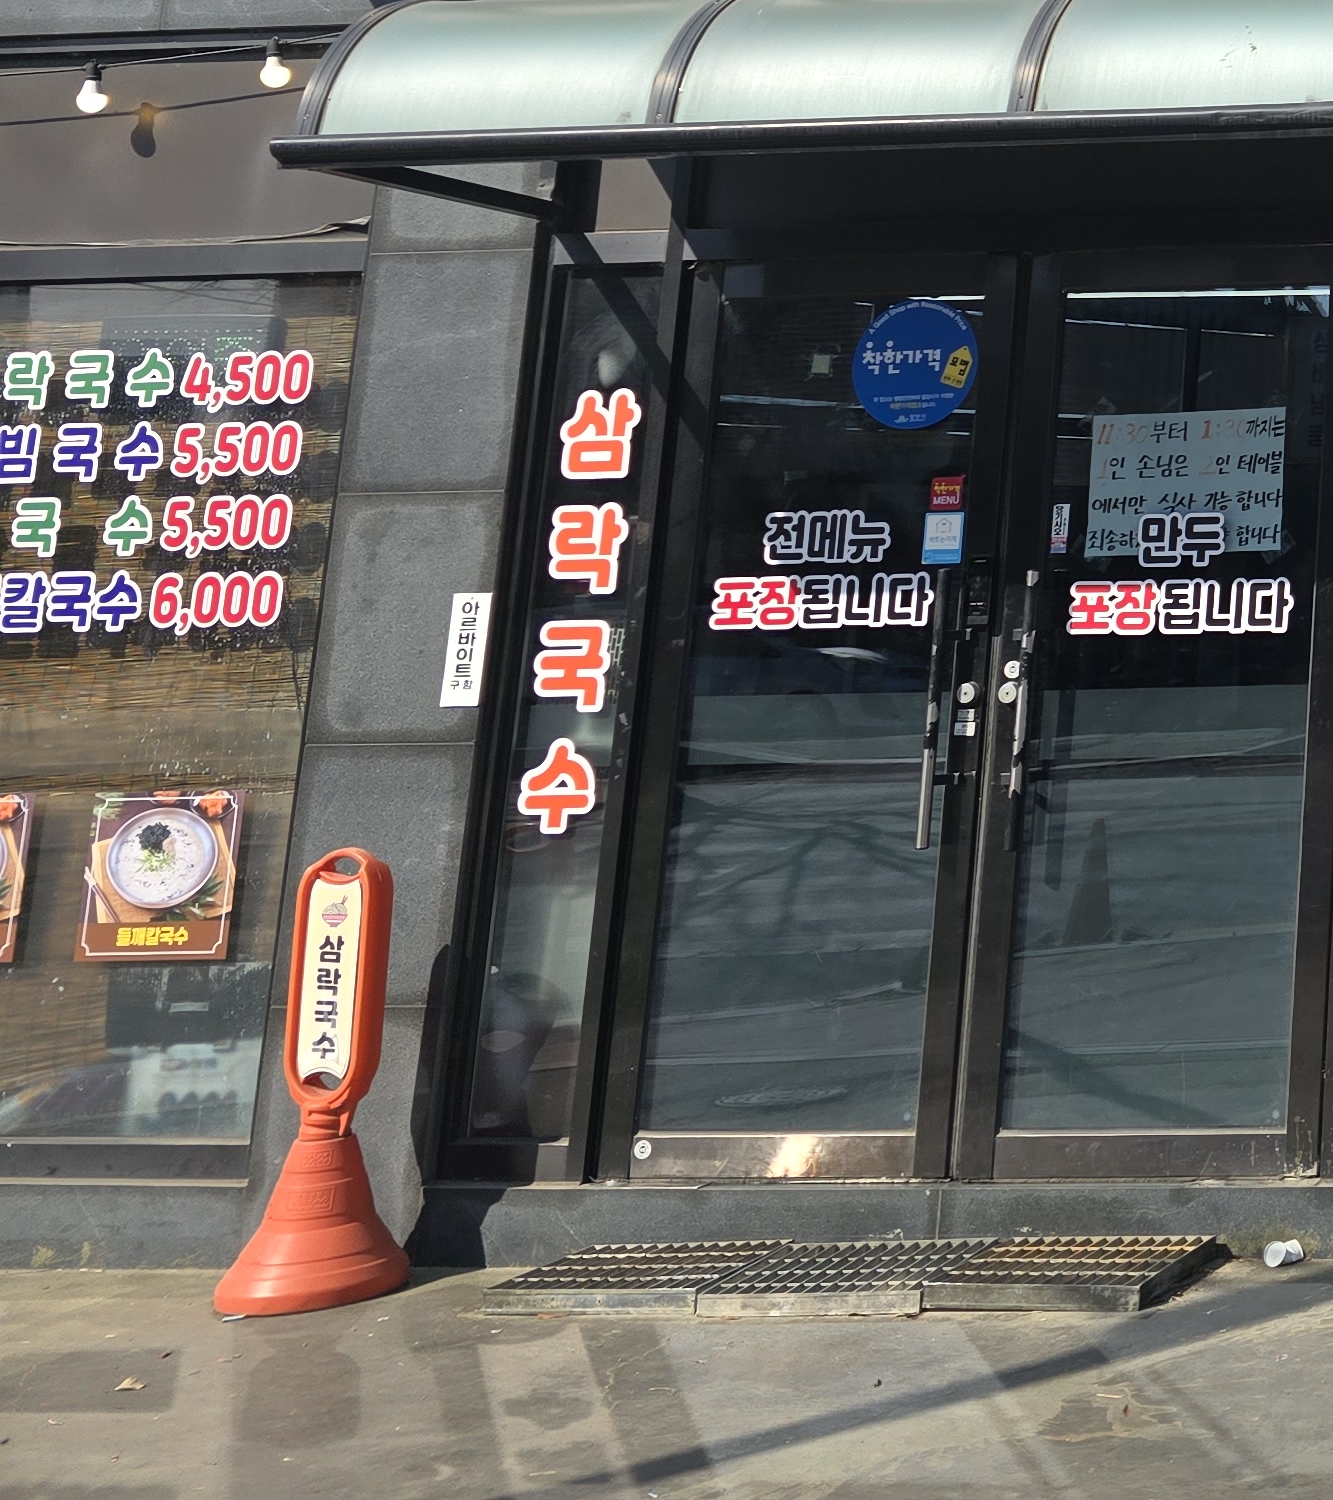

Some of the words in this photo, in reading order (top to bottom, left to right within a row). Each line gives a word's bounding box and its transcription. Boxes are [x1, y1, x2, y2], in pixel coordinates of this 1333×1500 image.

[180, 349, 314, 412] 4,500
[862, 340, 942, 375] 착한가격
[170, 421, 303, 484] 5,500
[1135, 453, 1190, 479] 손님은
[1237, 450, 1283, 475] 테이블
[160, 494, 293, 558] 5,500
[932, 495, 960, 505] MENU
[1091, 494, 1147, 516] 에서만
[1157, 491, 1197, 512] 식사
[1235, 488, 1284, 511] 합니다
[762, 510, 893, 566] 전메뉴
[1137, 511, 1227, 568] 만두
[1235, 524, 1282, 548] 합니다
[150, 571, 284, 636] 6,000
[517, 388, 641, 834] 삼락국수
[708, 572, 937, 631] 포장됩니다
[1067, 577, 1295, 636] 포장됩니다
[453, 601, 481, 678] 아르바이트
[116, 926, 189, 947] 들깨칼국수
[311, 934, 345, 1060] 삼락국수
